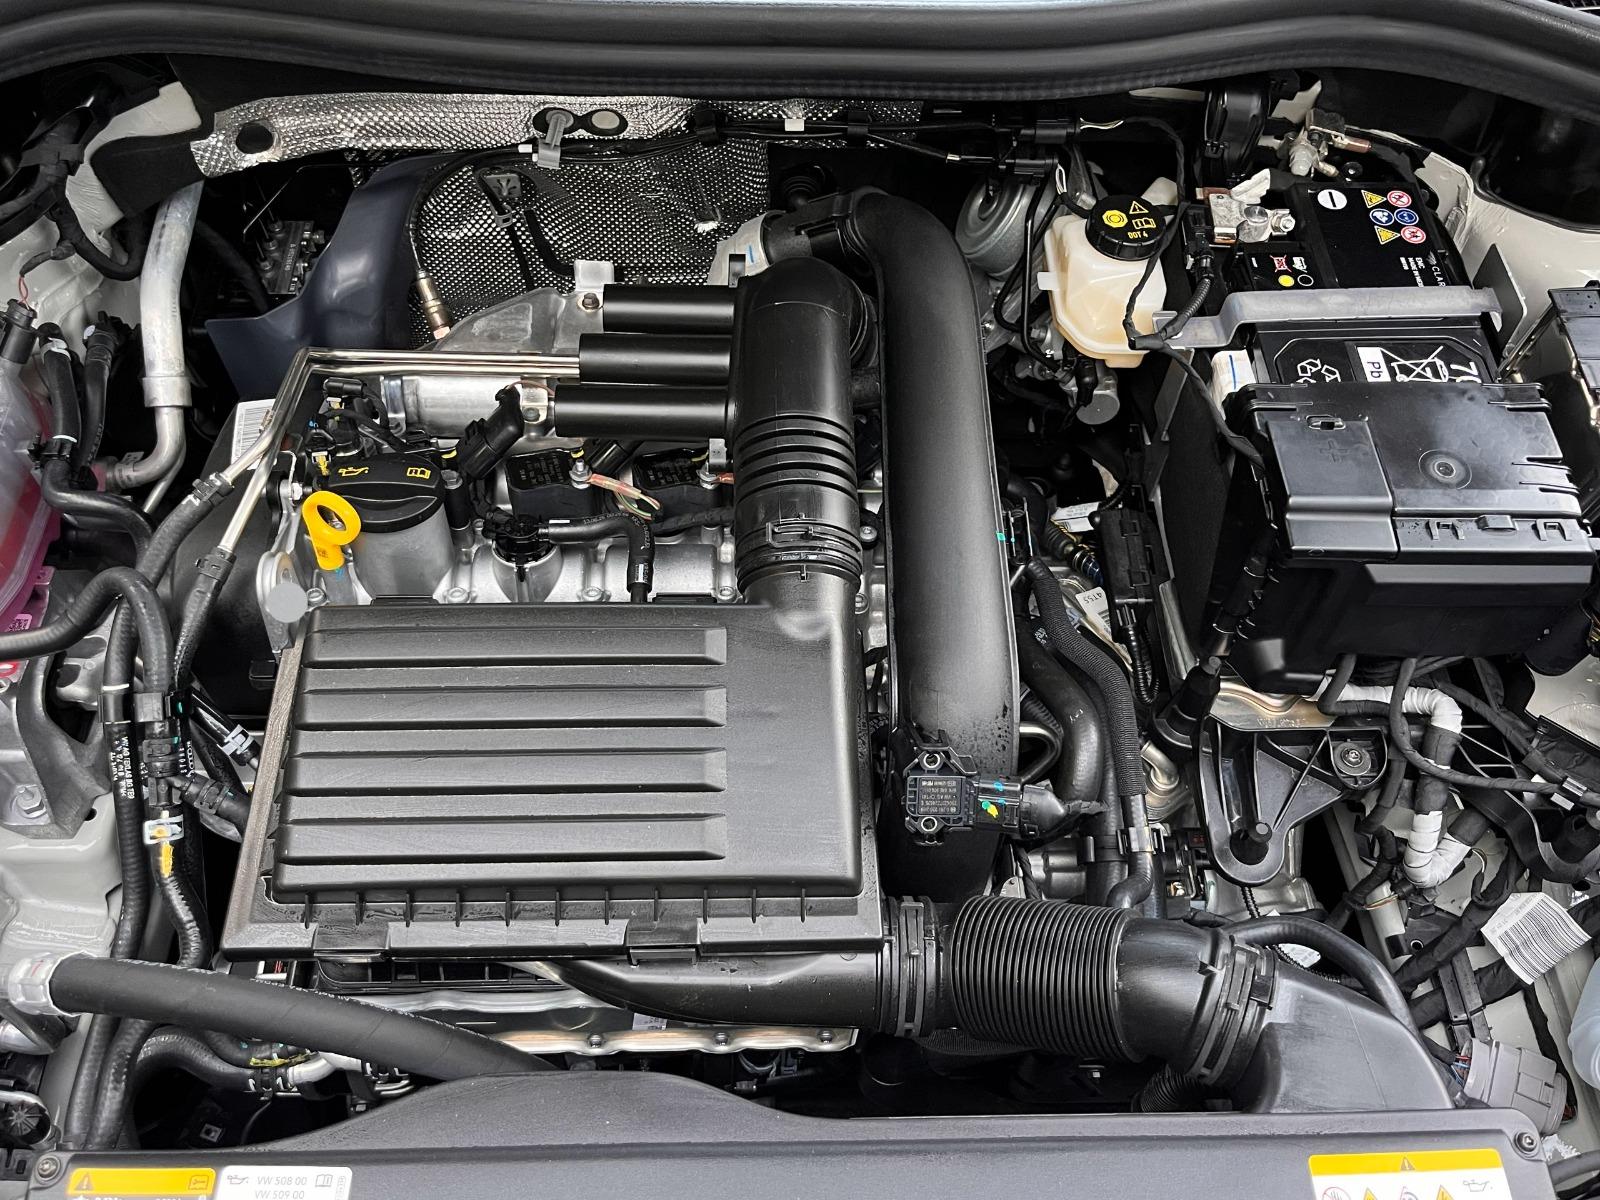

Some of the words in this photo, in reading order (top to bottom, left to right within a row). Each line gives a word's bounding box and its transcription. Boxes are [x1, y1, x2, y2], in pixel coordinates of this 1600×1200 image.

[1127, 231, 1141, 239] DOT
[1143, 230, 1149, 238] 4
[1408, 257, 1418, 270] MADE
[1366, 361, 1382, 379] Pb
[257, 1176, 272, 1185] VW
[274, 1176, 293, 1186] 508
[294, 1176, 308, 1186] 00
[254, 1190, 271, 1199] VW
[272, 1190, 290, 1200] 509
[292, 1190, 305, 1200] 00
